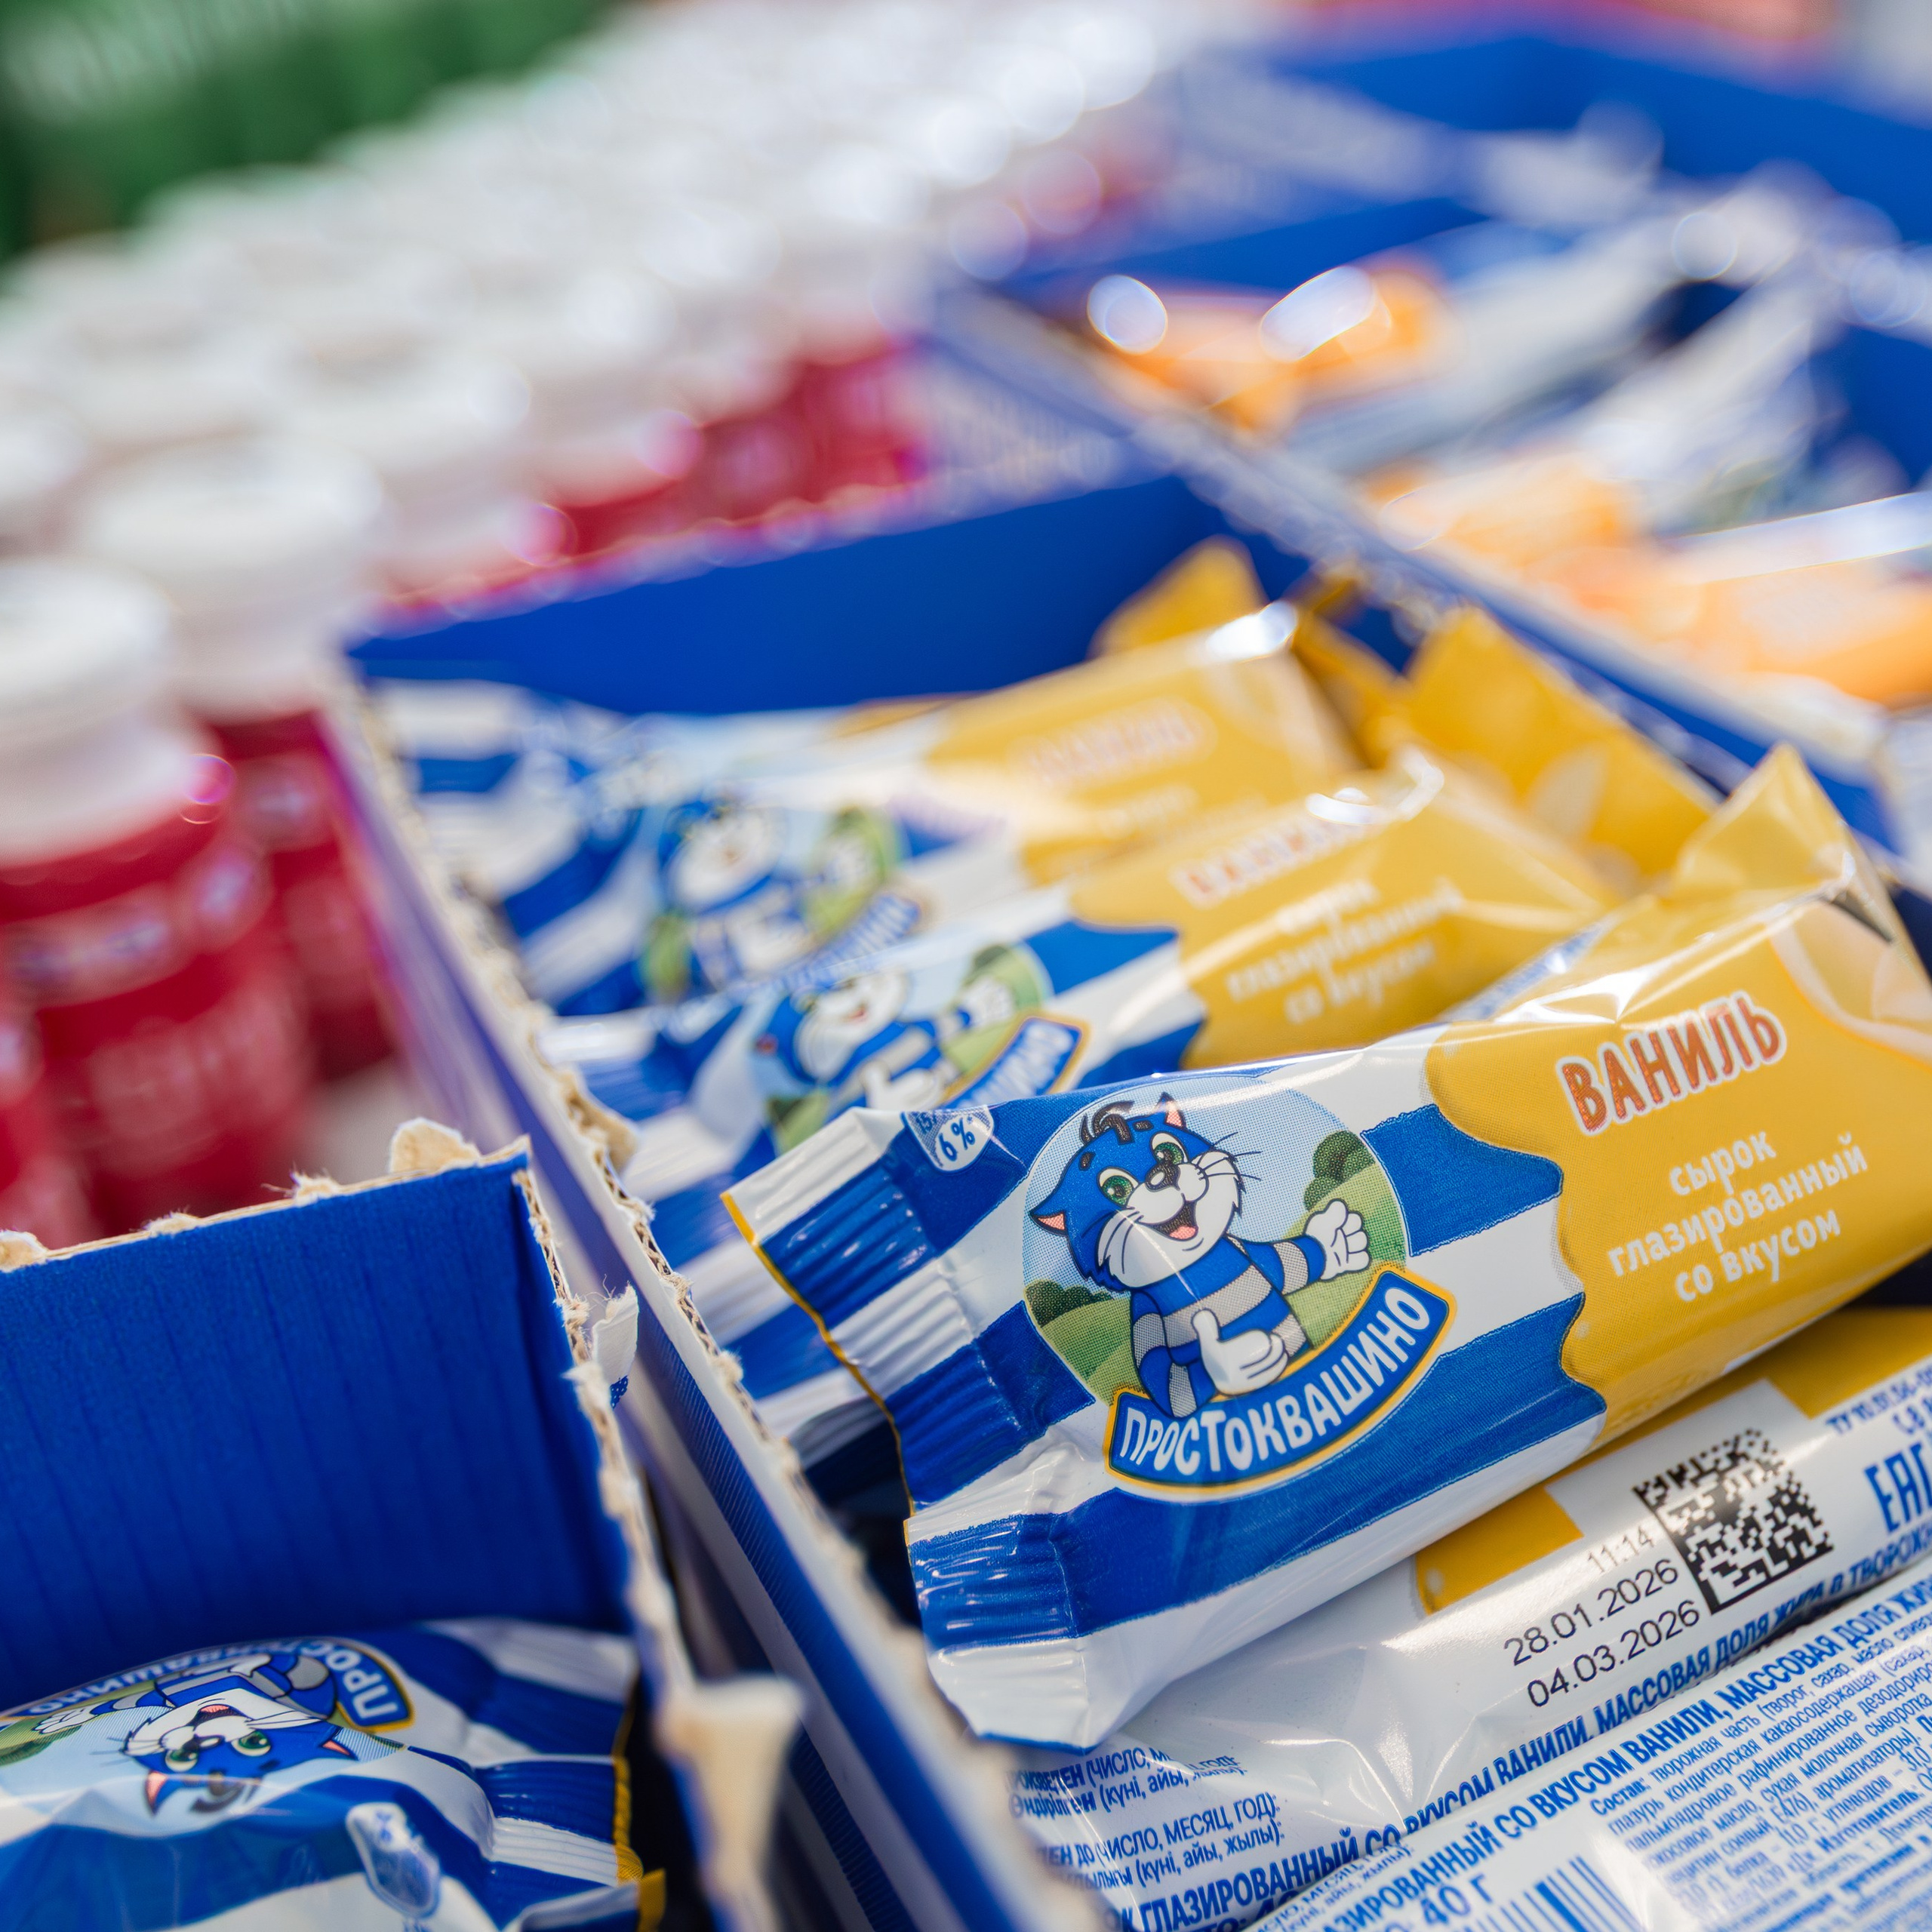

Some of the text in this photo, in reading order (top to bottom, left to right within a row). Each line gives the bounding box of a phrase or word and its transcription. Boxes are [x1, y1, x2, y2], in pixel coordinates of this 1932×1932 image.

[1557, 991, 1785, 1134] ВАНИЛЬ
[1607, 1131, 1869, 1278] глазированный
[1669, 1131, 1777, 1196] сырок
[1674, 1209, 1841, 1302] со вкусом
[1118, 1287, 1431, 1476] ПРОСТОКВАШИНО
[1587, 1524, 1655, 1573] 11:14
[1504, 1558, 1678, 1666] 28.01.2026
[1527, 1599, 1700, 1706] 04.03.2026
[1493, 1804, 1538, 1839] СО
[1526, 1748, 1635, 1820] ВКУСОМ
[1620, 1698, 1734, 1765] ВАНИЛИ,
[1713, 1634, 1846, 1710] МАССОВАЯ
[1831, 1602, 1902, 1651] ДОЛЯ
[1589, 1777, 1651, 1816] Состав:
[1650, 1735, 1724, 1783] творожная
[1719, 1714, 1761, 1740] часть
[1756, 1684, 1816, 1721] (творог,
[1607, 1798, 1666, 1837] глазурь
[1663, 1738, 1763, 1804] кондитерская
[1760, 1669, 1882, 1745] какаосодержащая
[1737, 1709, 1859, 1792] рафинированное
[1759, 1771, 1803, 1810] сухая
[1798, 1730, 1868, 1780] молочная
[1864, 1693, 1932, 1738] сыворотка
[1811, 1725, 1922, 1801] ароматизаторы).
[1140, 1826, 1358, 1932] ГЛАЗИРОВАННЫЙ
[1592, 1645, 1711, 1734] МАССОВАЯ
[1163, 1807, 1234, 1847] МЕСЯЦ,
[1183, 1840, 1223, 1868] айы,
[1223, 1818, 1284, 1855] жылы):
